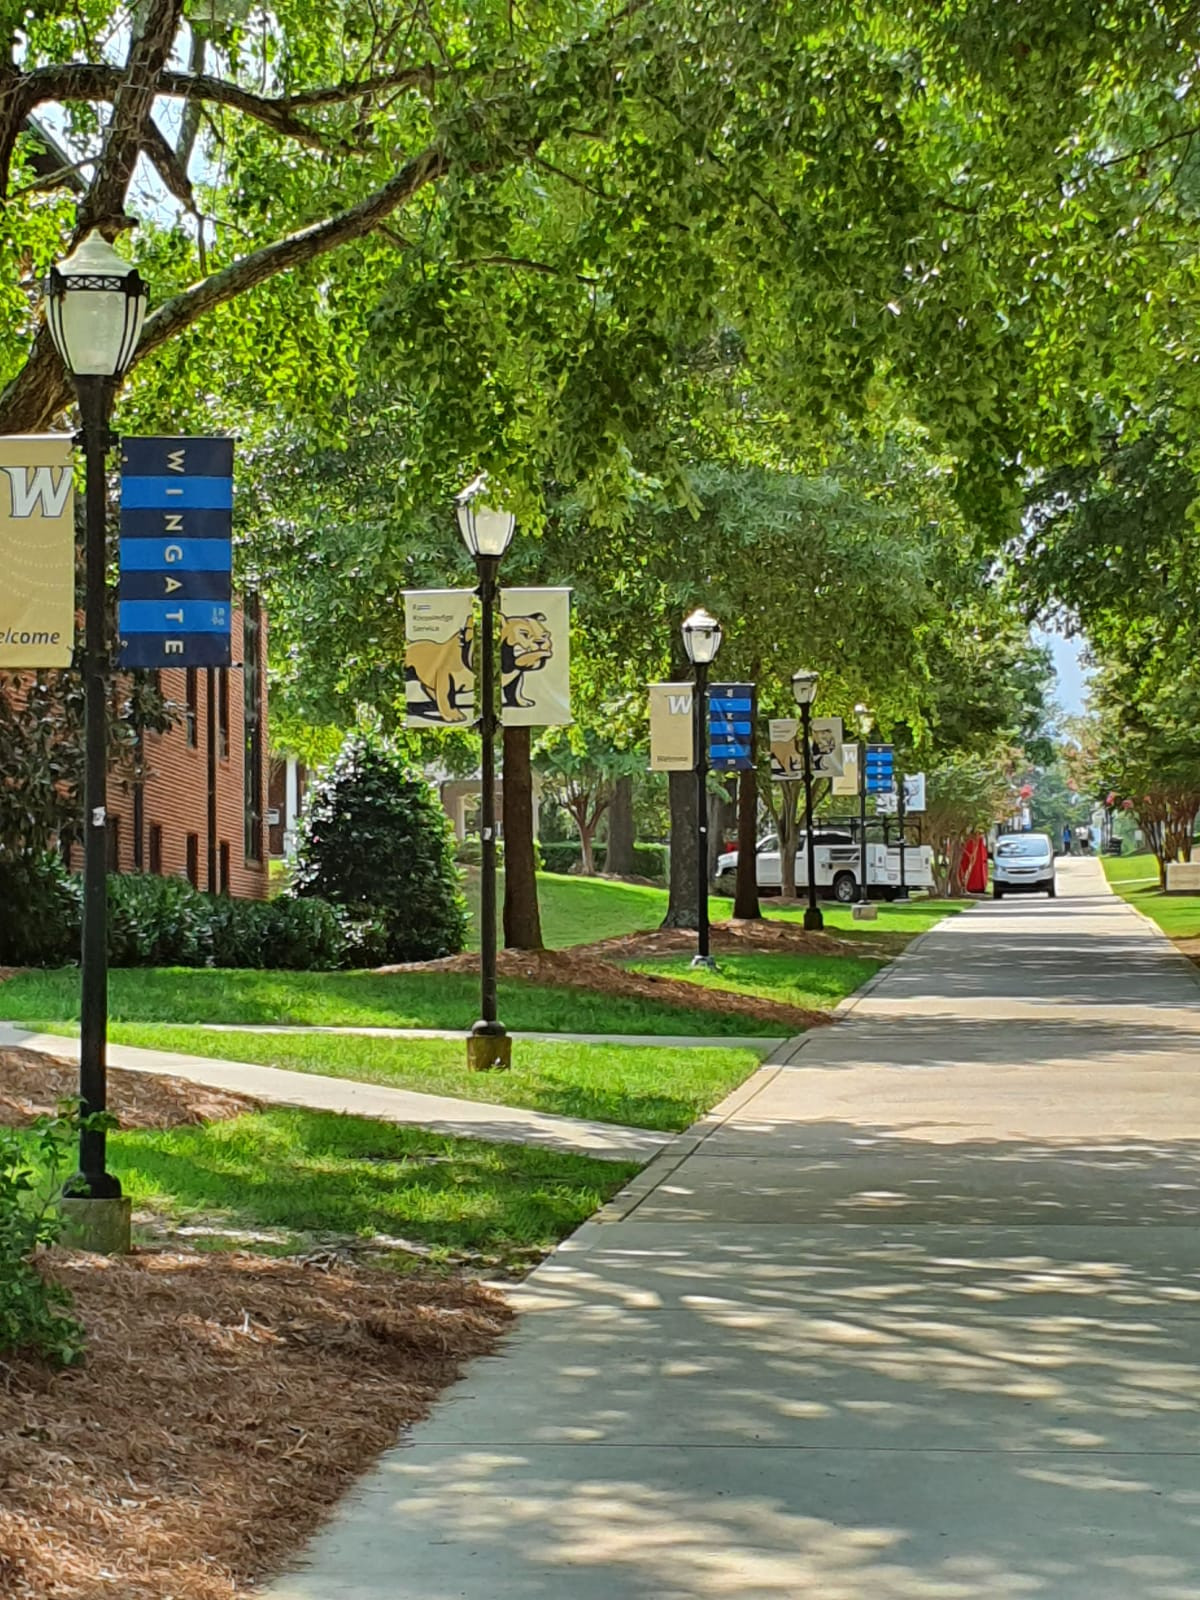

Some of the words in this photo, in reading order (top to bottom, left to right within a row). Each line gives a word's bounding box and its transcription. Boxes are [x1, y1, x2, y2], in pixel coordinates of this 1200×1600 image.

[0, 465, 74, 518] W
[164, 449, 186, 654] WINGATE
[0, 626, 60, 645] elcome
[666, 695, 692, 715] W
